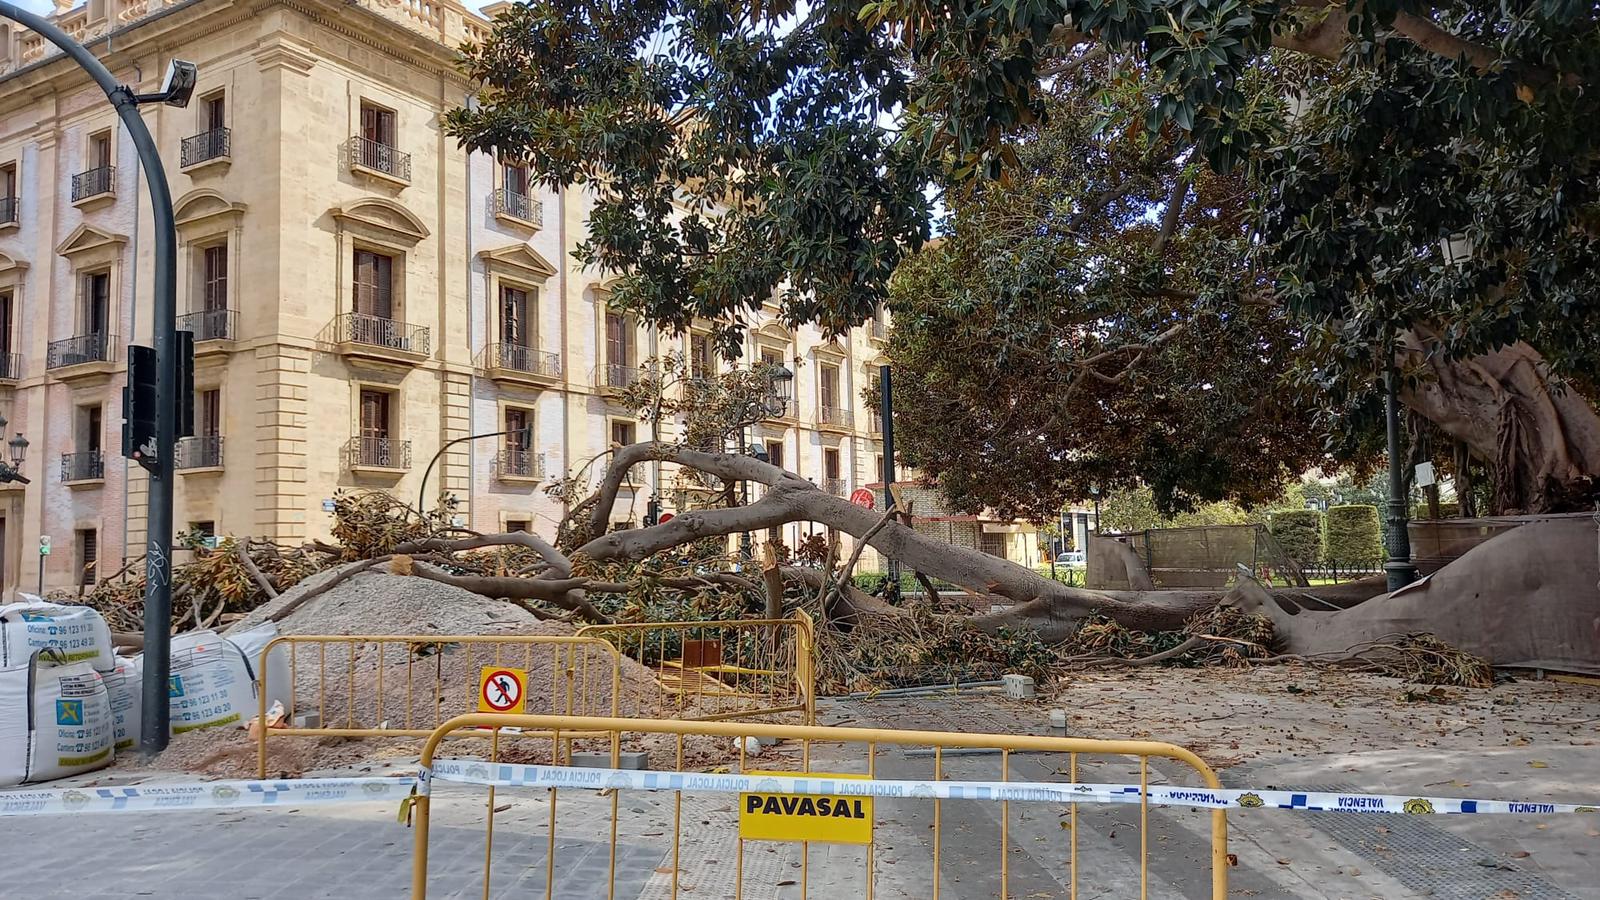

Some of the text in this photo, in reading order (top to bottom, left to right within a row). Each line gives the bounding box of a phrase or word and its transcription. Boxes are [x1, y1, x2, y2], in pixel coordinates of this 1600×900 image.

[59, 625, 67, 635] 96
[69, 624, 79, 634] 123
[80, 624, 86, 632] 11
[60, 639, 68, 649] 96
[70, 639, 80, 648] 123
[198, 695, 210, 705] 123
[201, 708, 213, 718] 123
[222, 702, 232, 713] 20
[117, 728, 126, 738] 20
[746, 795, 865, 819] PAVASAL
[1338, 797, 1384, 808] VALENCIA
[1508, 803, 1554, 813] VALENCIA
